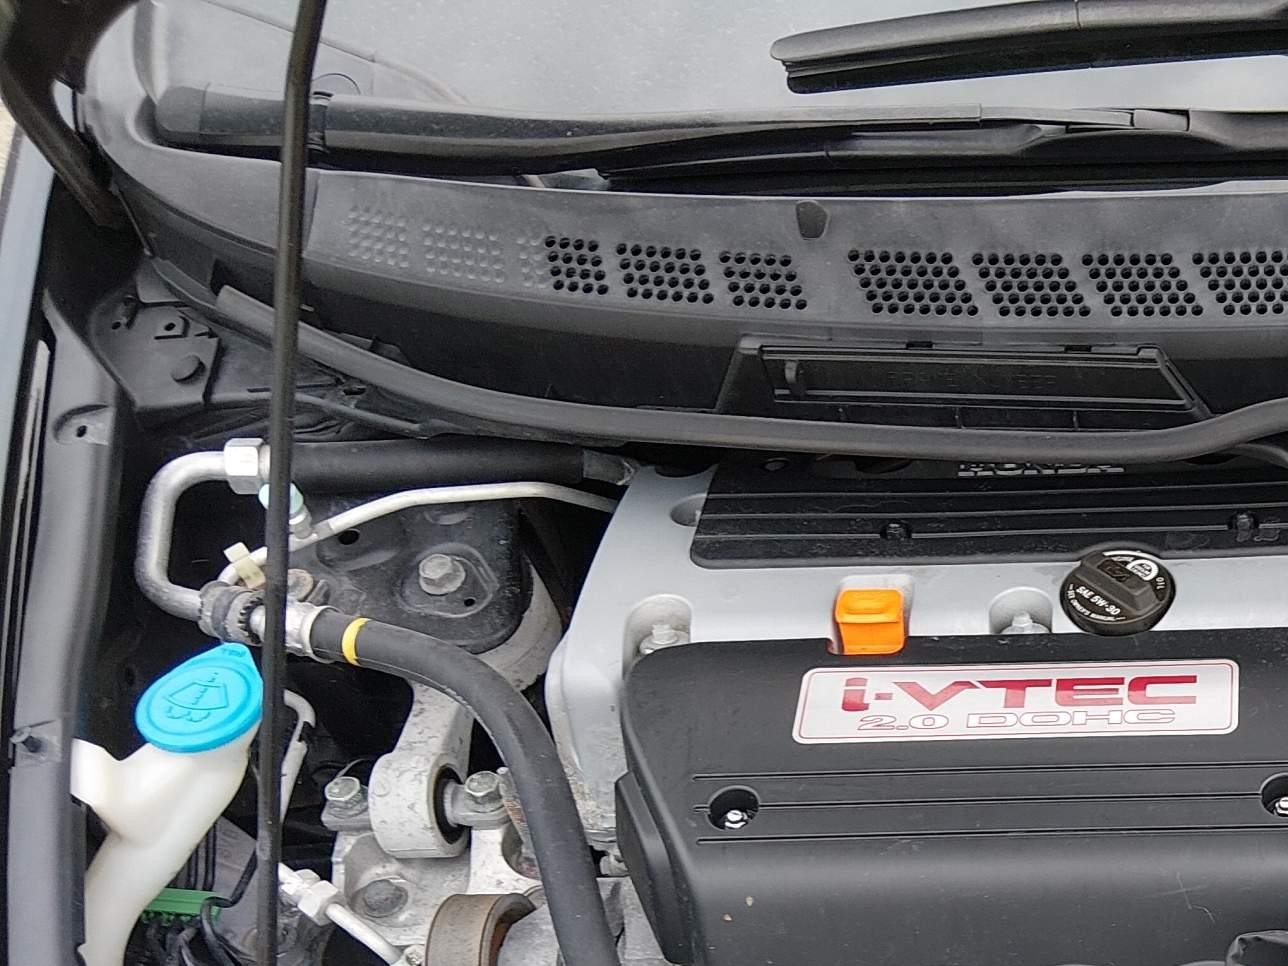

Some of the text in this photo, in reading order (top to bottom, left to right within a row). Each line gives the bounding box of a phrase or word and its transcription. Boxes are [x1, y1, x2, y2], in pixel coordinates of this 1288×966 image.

[1076, 586, 1121, 615] SAE 5W-30
[841, 675, 1198, 712] i-VTEC
[857, 709, 1176, 731] 2.0 DOHC
